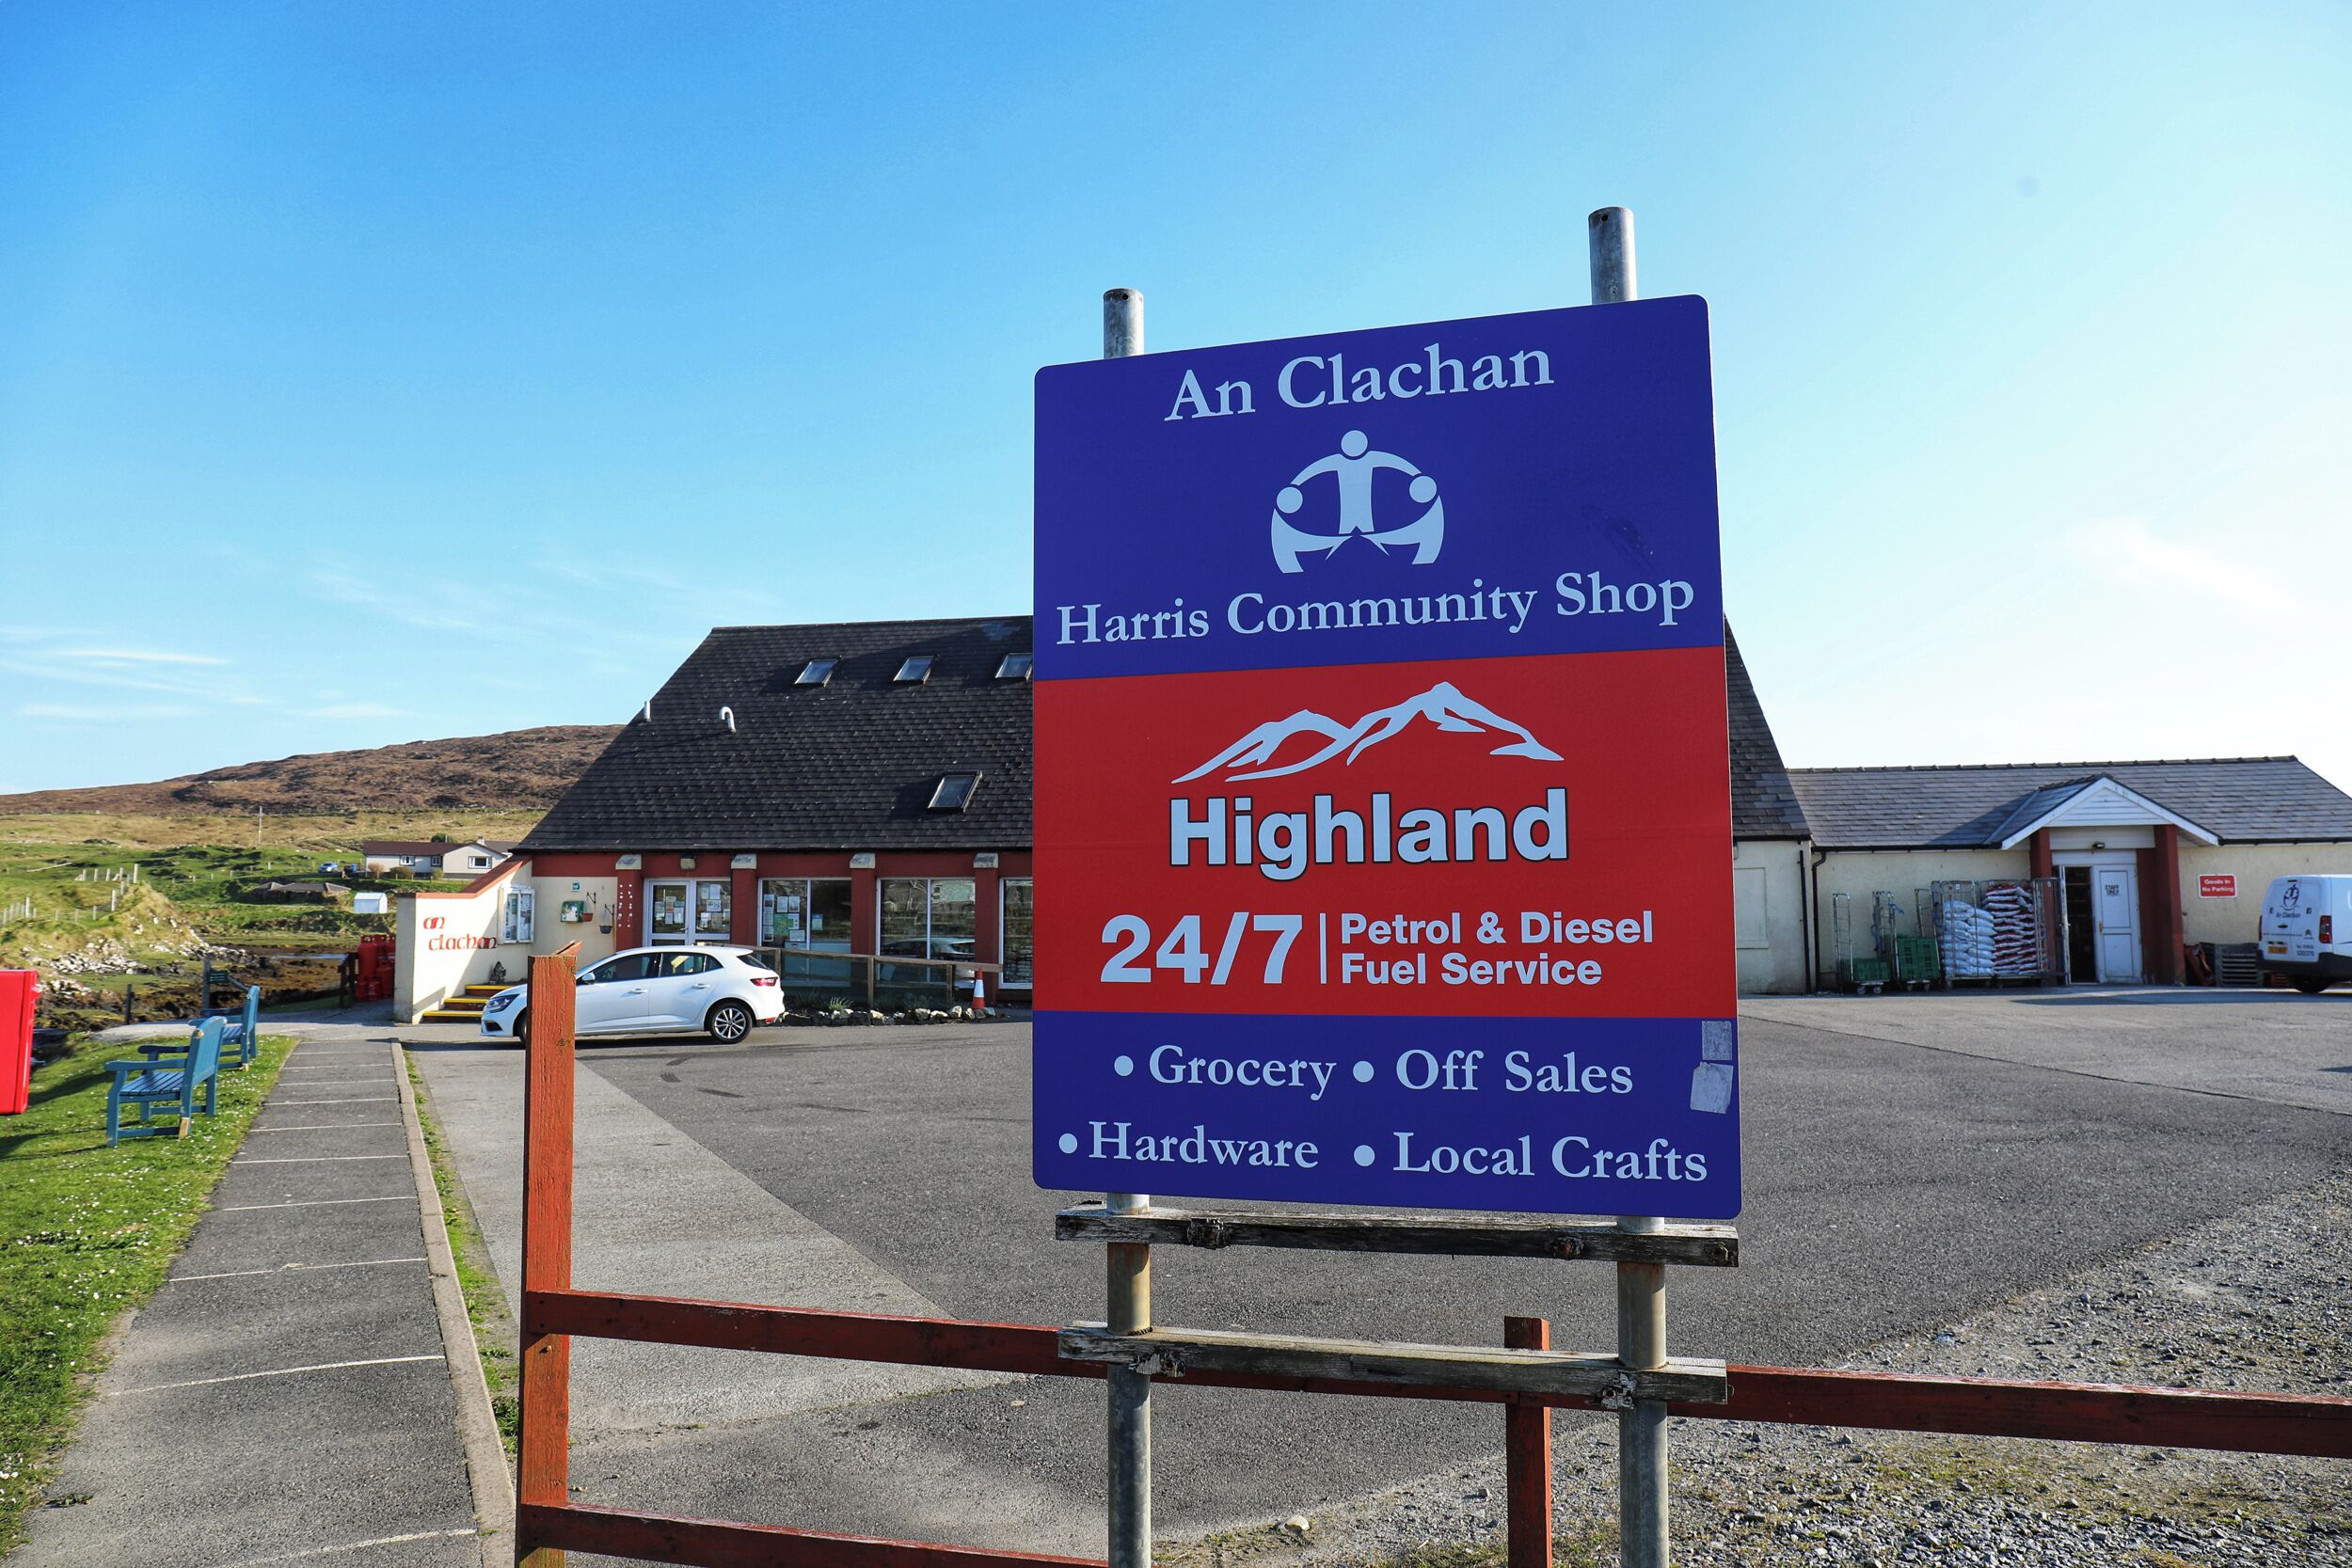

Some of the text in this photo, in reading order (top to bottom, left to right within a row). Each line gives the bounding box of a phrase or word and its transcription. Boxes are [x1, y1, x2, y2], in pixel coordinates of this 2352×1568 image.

[1165, 342, 1555, 421] An Clachan
[1057, 571, 1693, 644] Harris Community Shop
[1170, 788, 1567, 880] Highland
[1101, 912, 1302, 985] 24/7
[1342, 911, 1652, 943] Petrol & Diesel
[1343, 953, 1601, 985] Fuel Service
[1150, 1045, 1336, 1101] Grocery
[1397, 1050, 1632, 1093] Off Sales
[1089, 1121, 1318, 1167] Hardware
[1393, 1132, 1707, 1180] Local Crafts
